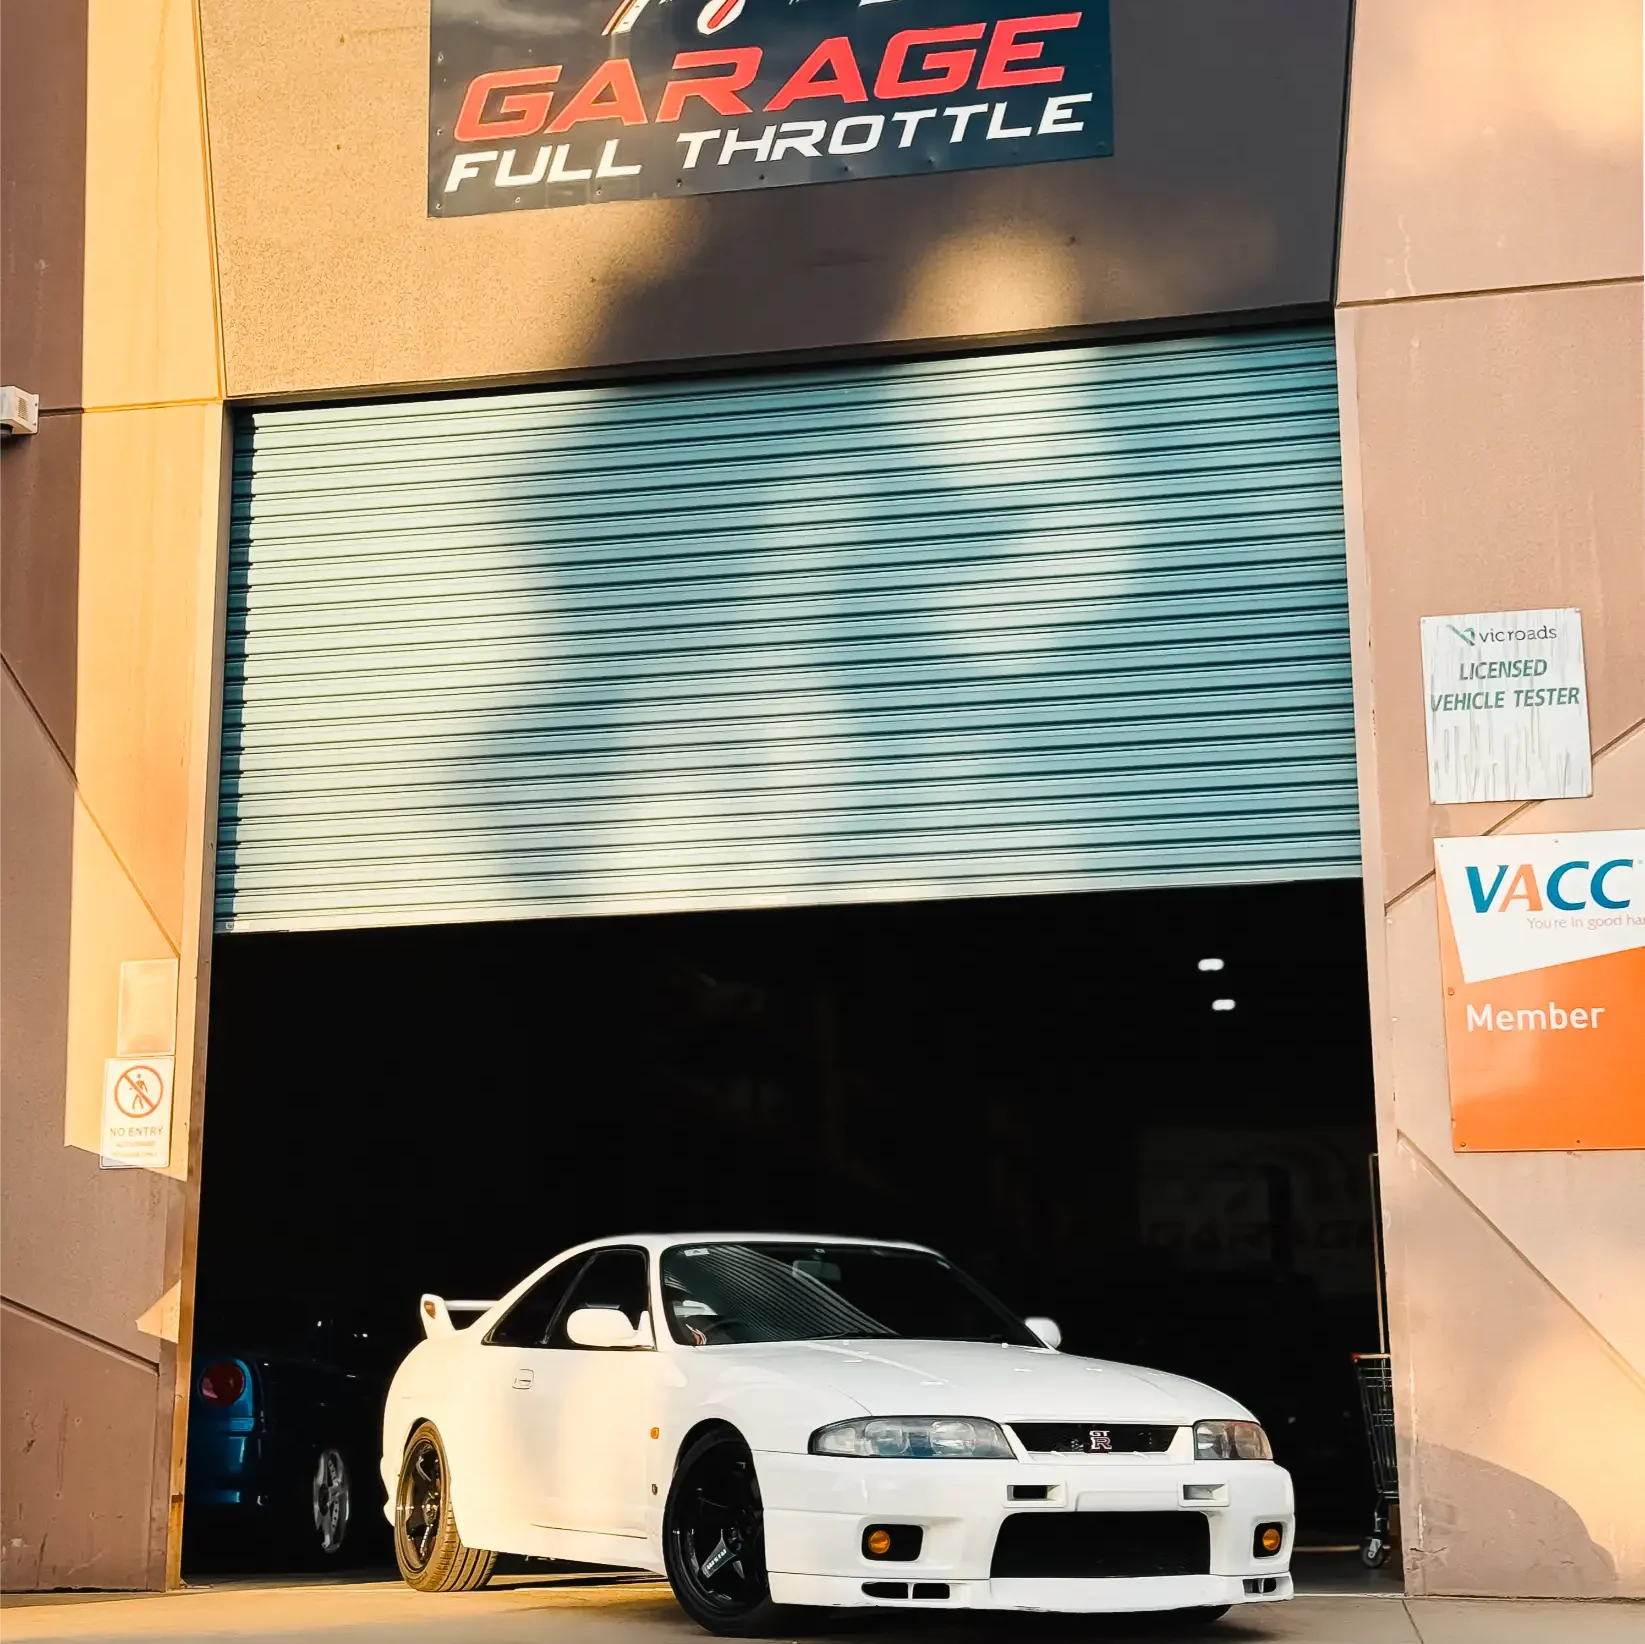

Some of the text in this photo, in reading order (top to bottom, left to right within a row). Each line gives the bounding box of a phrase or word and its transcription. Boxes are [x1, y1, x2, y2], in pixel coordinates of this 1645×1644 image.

[456, 12, 1083, 142] GARAGE
[444, 92, 1093, 193] FULL THROTTLE
[1459, 658, 1548, 681] LICENSED
[1430, 687, 1580, 712] VEHICLE TESTER
[1465, 859, 1634, 914] VACC
[1587, 915, 1622, 930] good
[1466, 1001, 1605, 1032] Member
[109, 1126, 164, 1137] NO ENTRY
[1090, 1436, 1112, 1450] R
